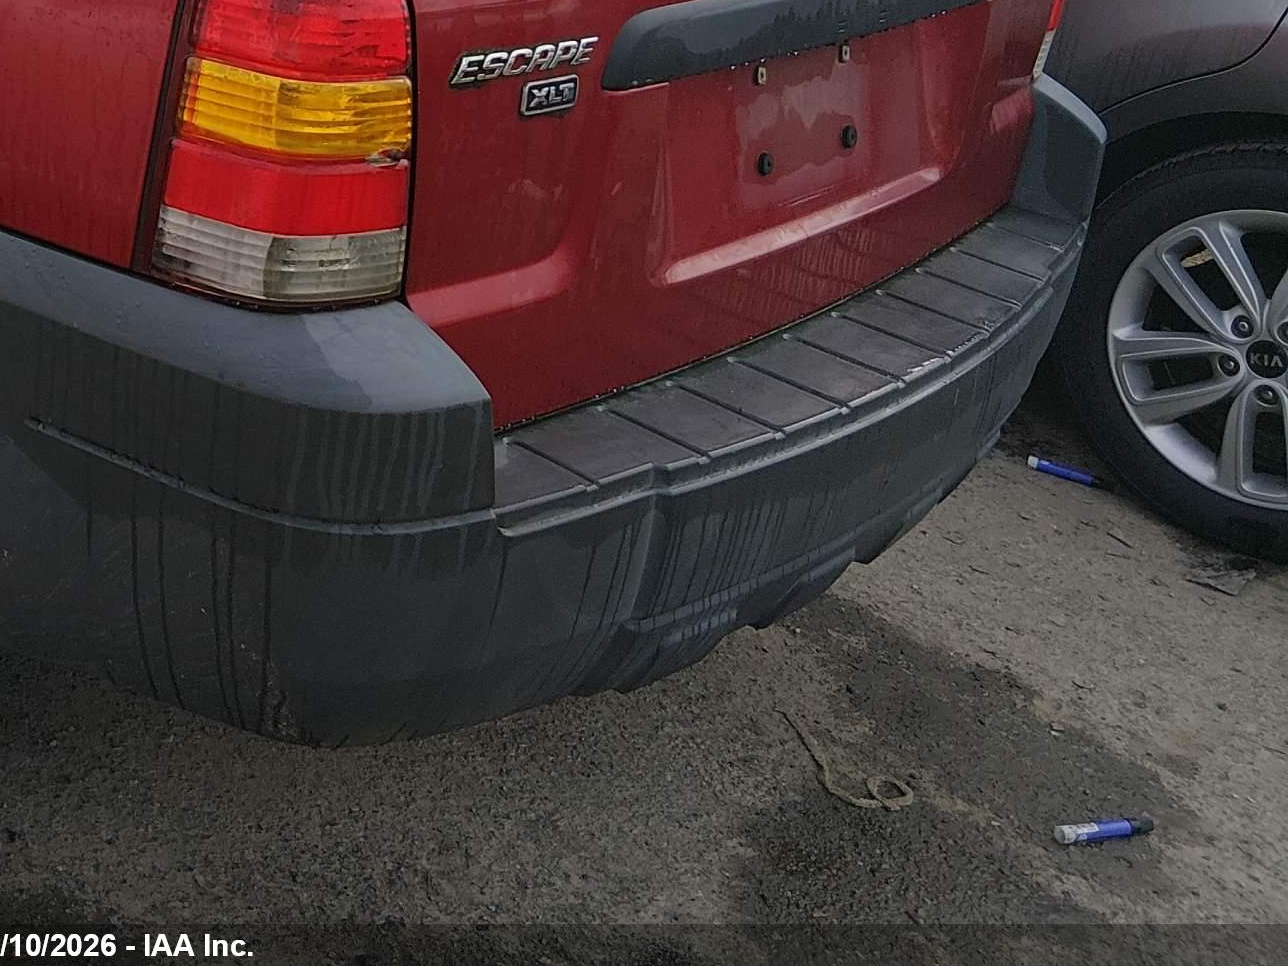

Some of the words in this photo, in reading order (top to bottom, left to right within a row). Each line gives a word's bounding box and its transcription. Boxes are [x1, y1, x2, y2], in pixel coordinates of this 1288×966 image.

[450, 35, 600, 85] ESCAPE
[528, 82, 575, 109] XLT
[1250, 353, 1284, 367] KIA
